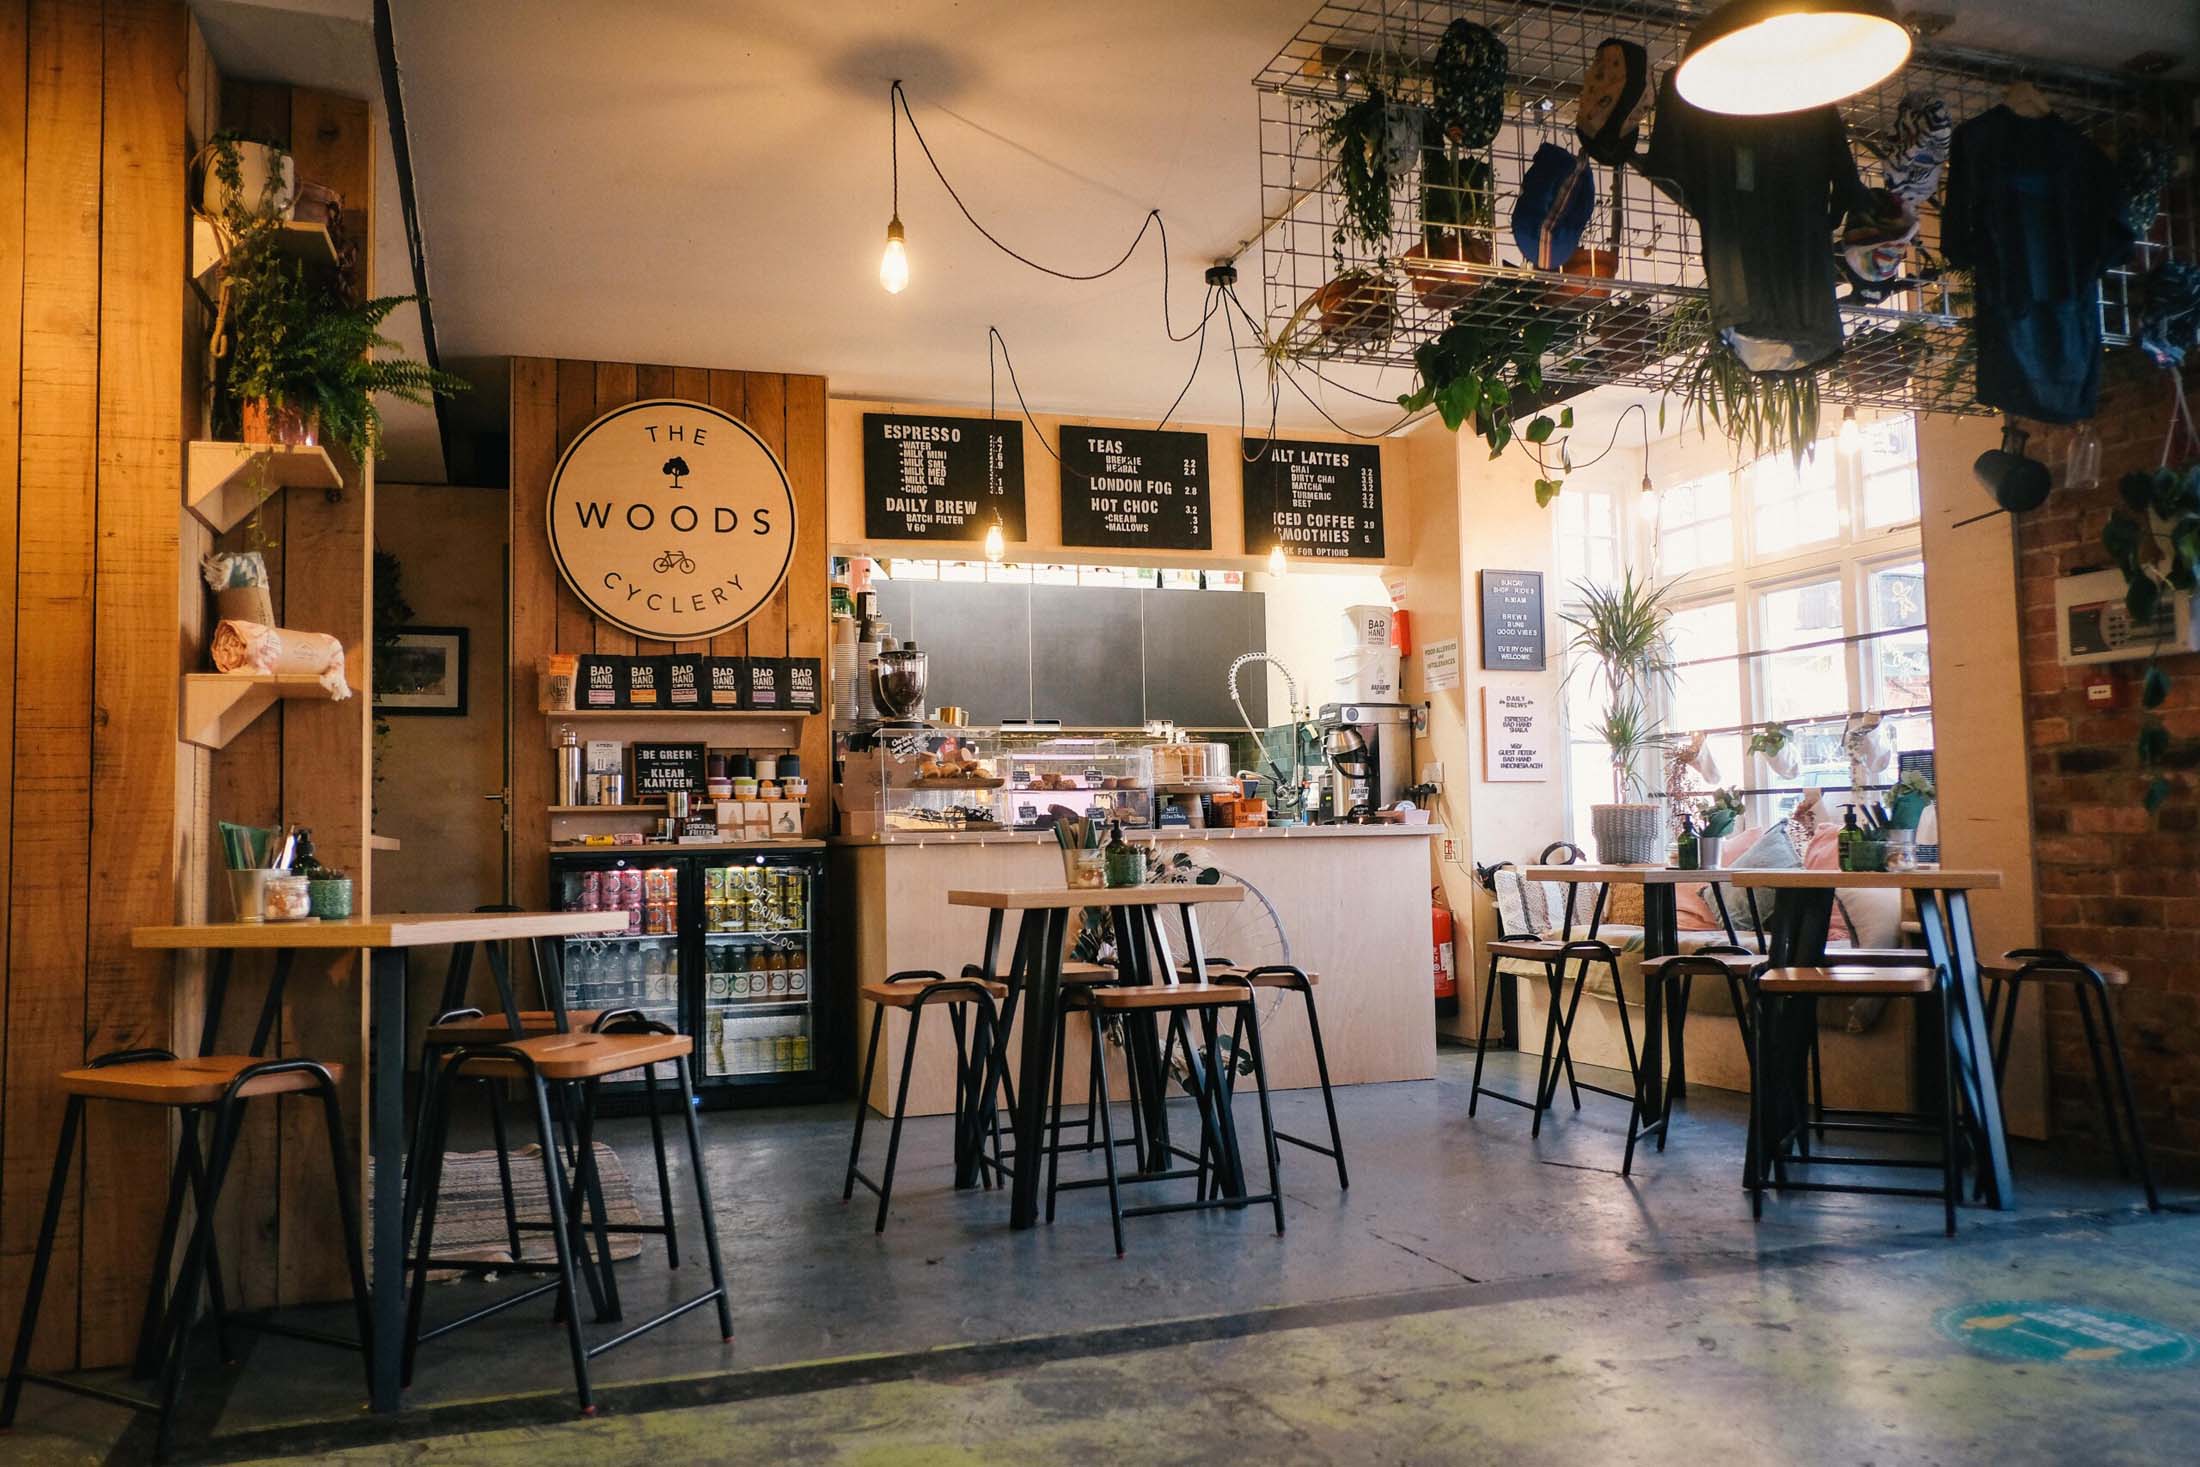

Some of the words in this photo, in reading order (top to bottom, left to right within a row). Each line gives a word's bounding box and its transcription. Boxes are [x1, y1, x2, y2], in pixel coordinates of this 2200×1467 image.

[645, 425, 707, 446] THE
[884, 424, 960, 442] ESPRESSO
[1088, 439, 1123, 454] TEAS
[927, 451, 947, 460] MINI
[1272, 449, 1294, 463] ALT
[1302, 451, 1349, 467] LATTES
[928, 460, 946, 469] SML
[1106, 455, 1142, 466] BREKKIE
[1184, 459, 1196, 467] 2.2
[928, 469, 947, 477] MED
[1106, 464, 1139, 474] HERBAL
[1291, 465, 1310, 473] CHAI
[1361, 468, 1373, 476] 3.2
[928, 477, 945, 486] LRG
[1291, 474, 1314, 483] DIRTY
[1317, 475, 1335, 484] CHAI
[1090, 477, 1142, 493] LONDON
[1147, 480, 1172, 495] FOG
[1185, 487, 1197, 495] 2.8
[1292, 483, 1322, 491] MATCHA
[1293, 491, 1332, 500] TURMERIC
[886, 498, 928, 512] DAILY
[936, 500, 977, 514] BREW
[1091, 498, 1118, 512] HOT
[1124, 500, 1158, 514] CHOC
[1185, 506, 1198, 514] 3.2
[1293, 500, 1312, 508] BEET
[576, 502, 771, 535] WOODS
[906, 514, 932, 523] BATCH
[936, 515, 964, 525] FILTER
[1190, 516, 1198, 525] .3
[1274, 512, 1301, 526] ICED
[1307, 514, 1355, 529] COFFEE
[1190, 526, 1198, 534] .3
[1298, 547, 1312, 556] FOR
[1316, 548, 1349, 557] OPTIONS
[604, 572, 743, 614] CYCLERY
[1368, 620, 1384, 629] BAD
[1368, 628, 1384, 637] HAND
[590, 666, 613, 676] BAD
[631, 667, 653, 677] BAD
[672, 665, 693, 676] BAD
[712, 668, 734, 677] BAD
[752, 668, 773, 678] BAD
[791, 669, 812, 678] BAD
[591, 674, 613, 684] HAND
[632, 674, 653, 684] HAND
[672, 674, 694, 684] HAND
[713, 676, 734, 685] HAND
[753, 677, 774, 685] HAND
[792, 677, 812, 686] HAND
[643, 750, 655, 760] BE
[660, 750, 692, 760] GREEN
[651, 768, 684, 778] KLEAN
[644, 779, 693, 788] KANTEEN
[744, 872, 776, 902] SOFT
[750, 899, 792, 928] DRINKS
